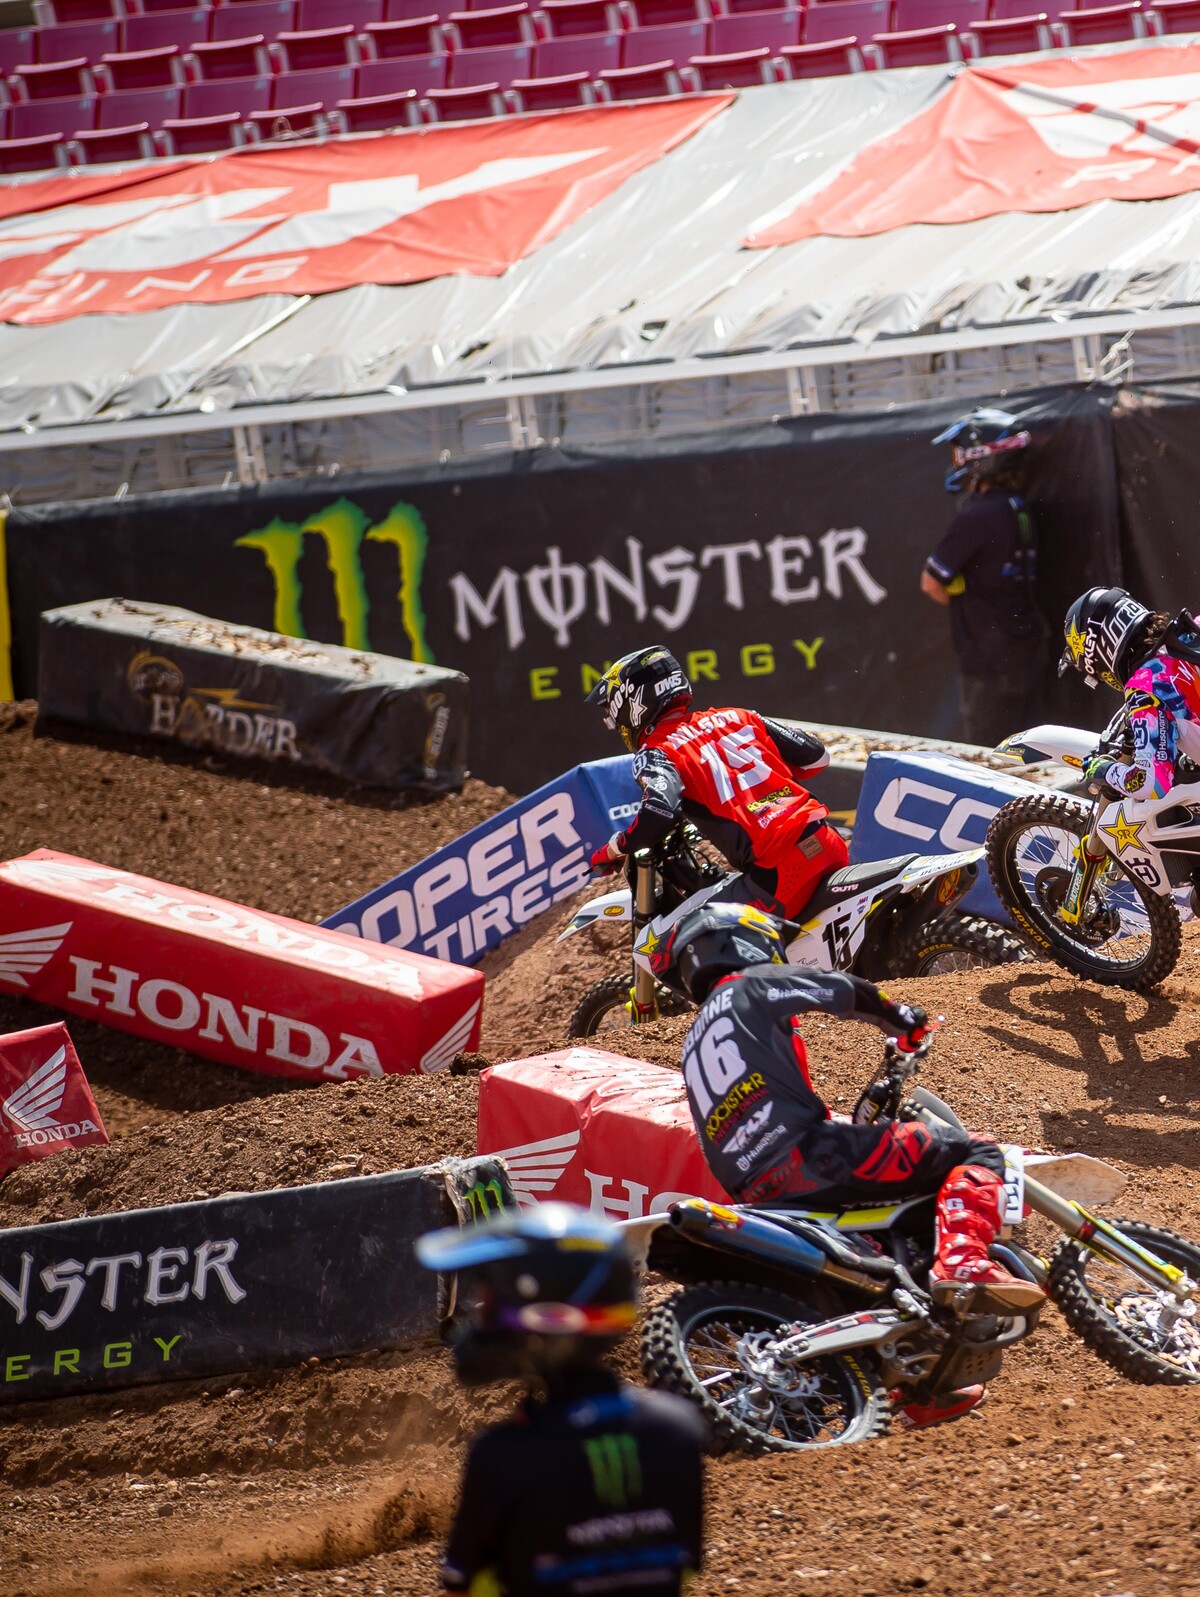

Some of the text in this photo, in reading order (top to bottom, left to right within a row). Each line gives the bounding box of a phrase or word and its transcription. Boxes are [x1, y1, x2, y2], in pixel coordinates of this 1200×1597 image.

[449, 526, 888, 650] MONSTER
[531, 636, 825, 701] ENRGY
[1084, 627, 1098, 674] OAKLEY
[700, 724, 773, 804] 15
[422, 845, 592, 961] TIRES
[831, 882, 860, 893] GUTS
[94, 882, 424, 1001] HONDA
[821, 911, 853, 972] 15
[1011, 906, 1051, 949] DUNLOP
[67, 954, 385, 1080] HONDA
[684, 1015, 748, 1120] 16
[13, 1119, 100, 1149] HONDA
[5, 1335, 181, 1382] ERGY
